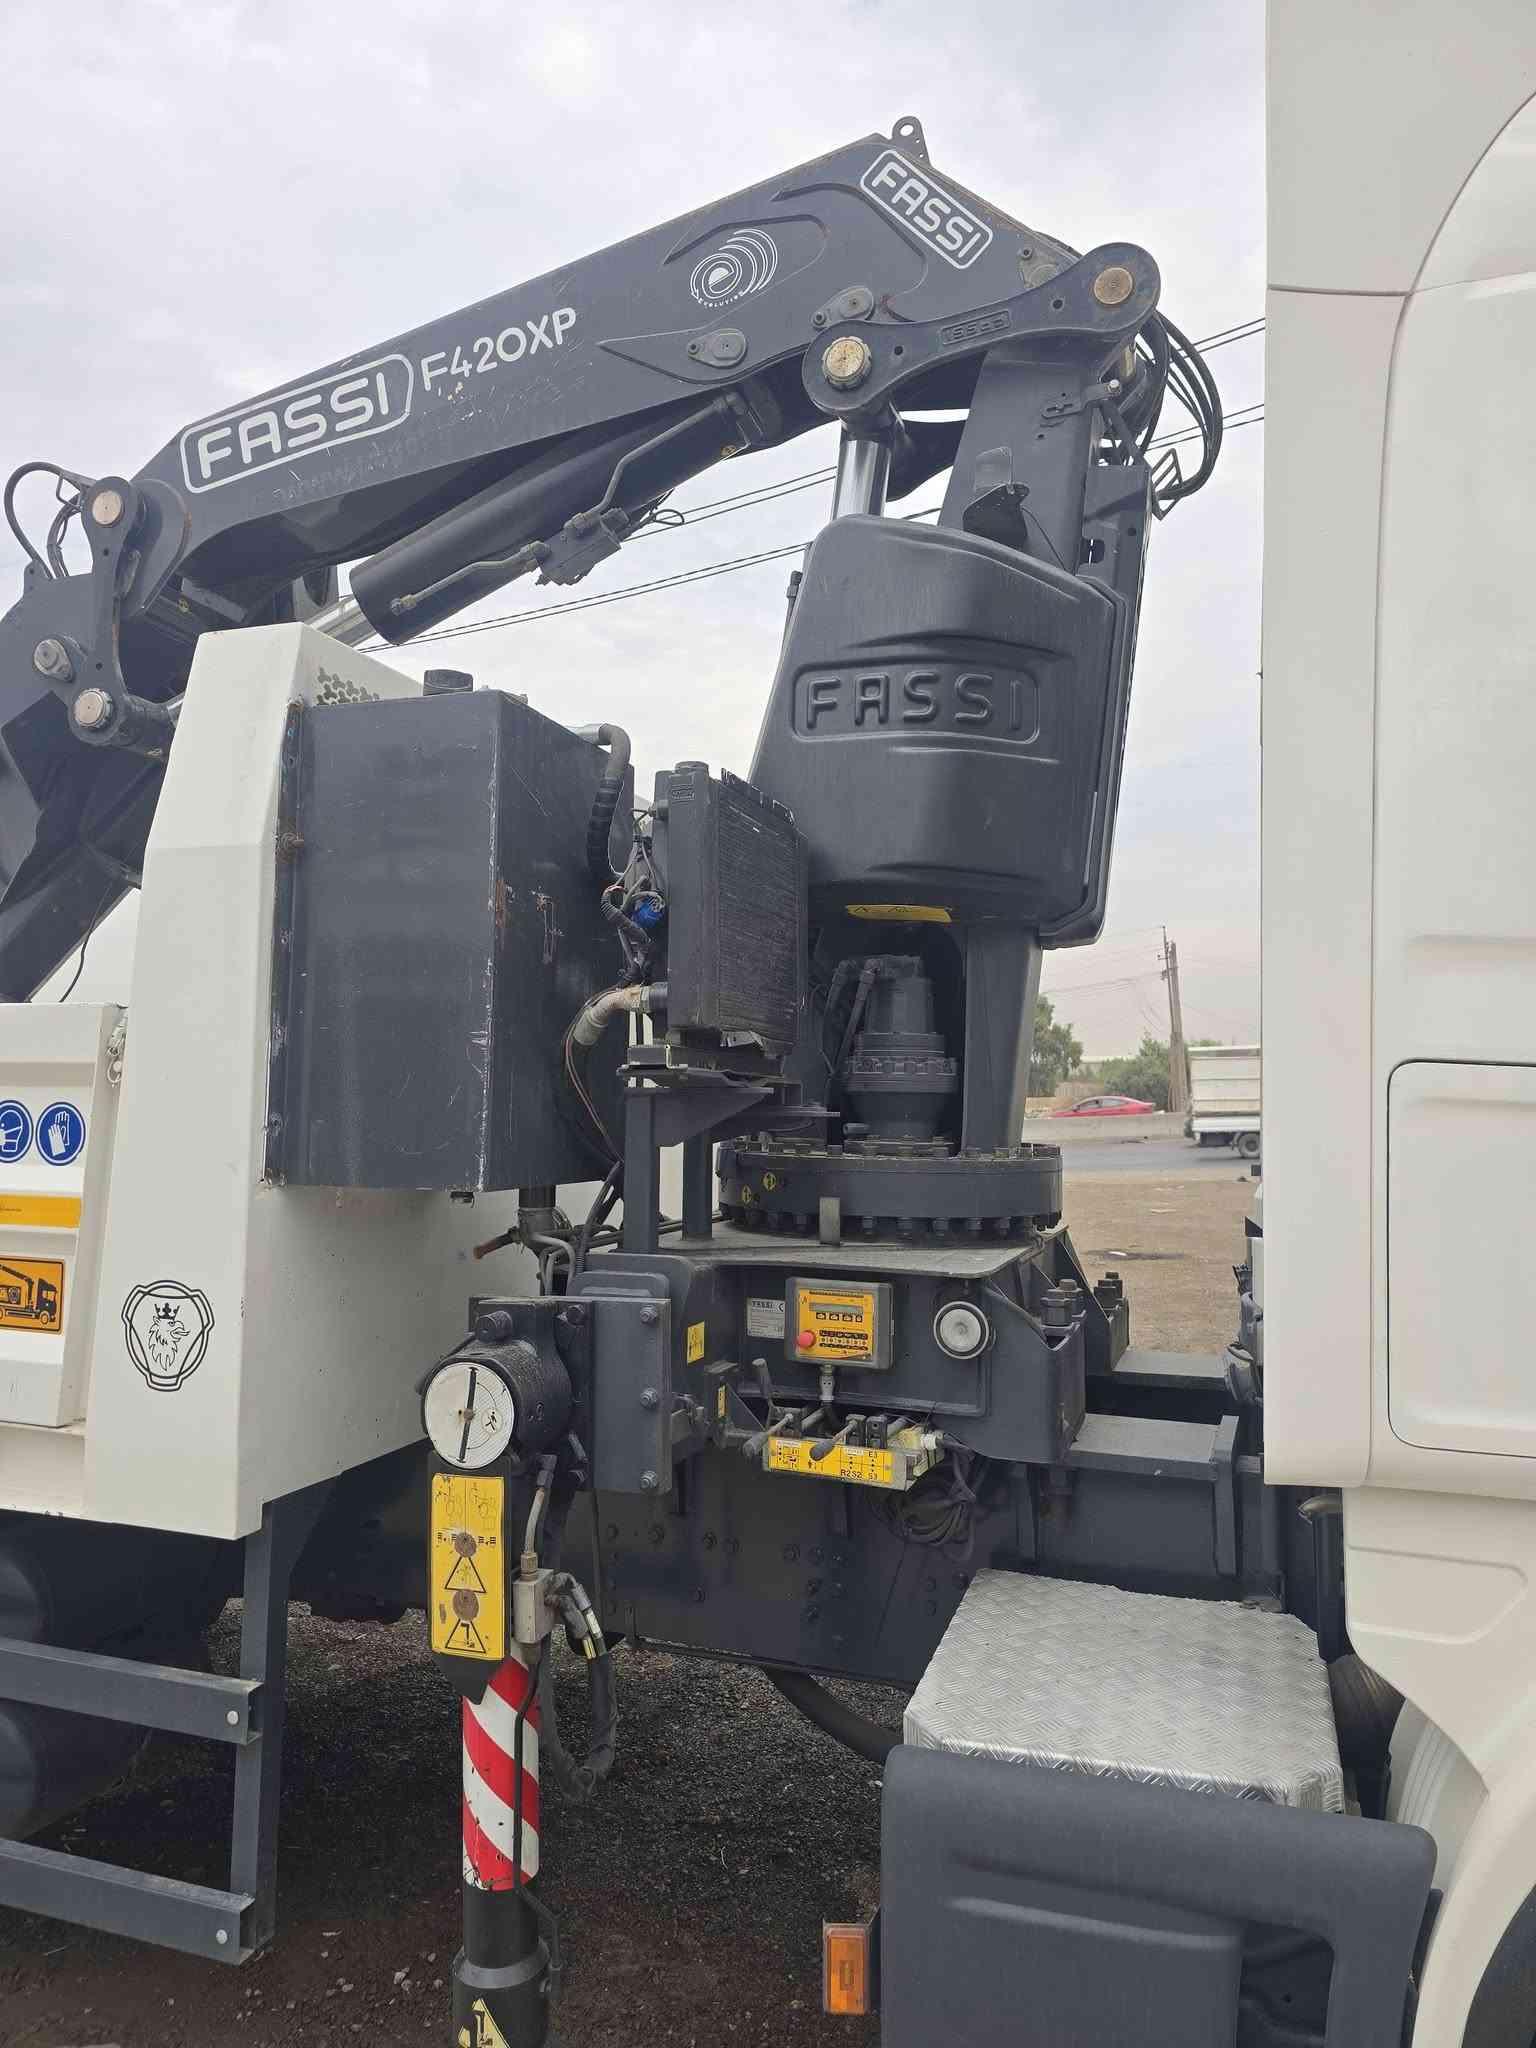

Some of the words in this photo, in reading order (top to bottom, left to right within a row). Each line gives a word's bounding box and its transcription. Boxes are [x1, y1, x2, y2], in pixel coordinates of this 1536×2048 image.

[871, 161, 981, 258] FASSI
[198, 371, 389, 479] FASSI
[421, 306, 577, 391] F420XP
[806, 671, 1023, 730] FASSI
